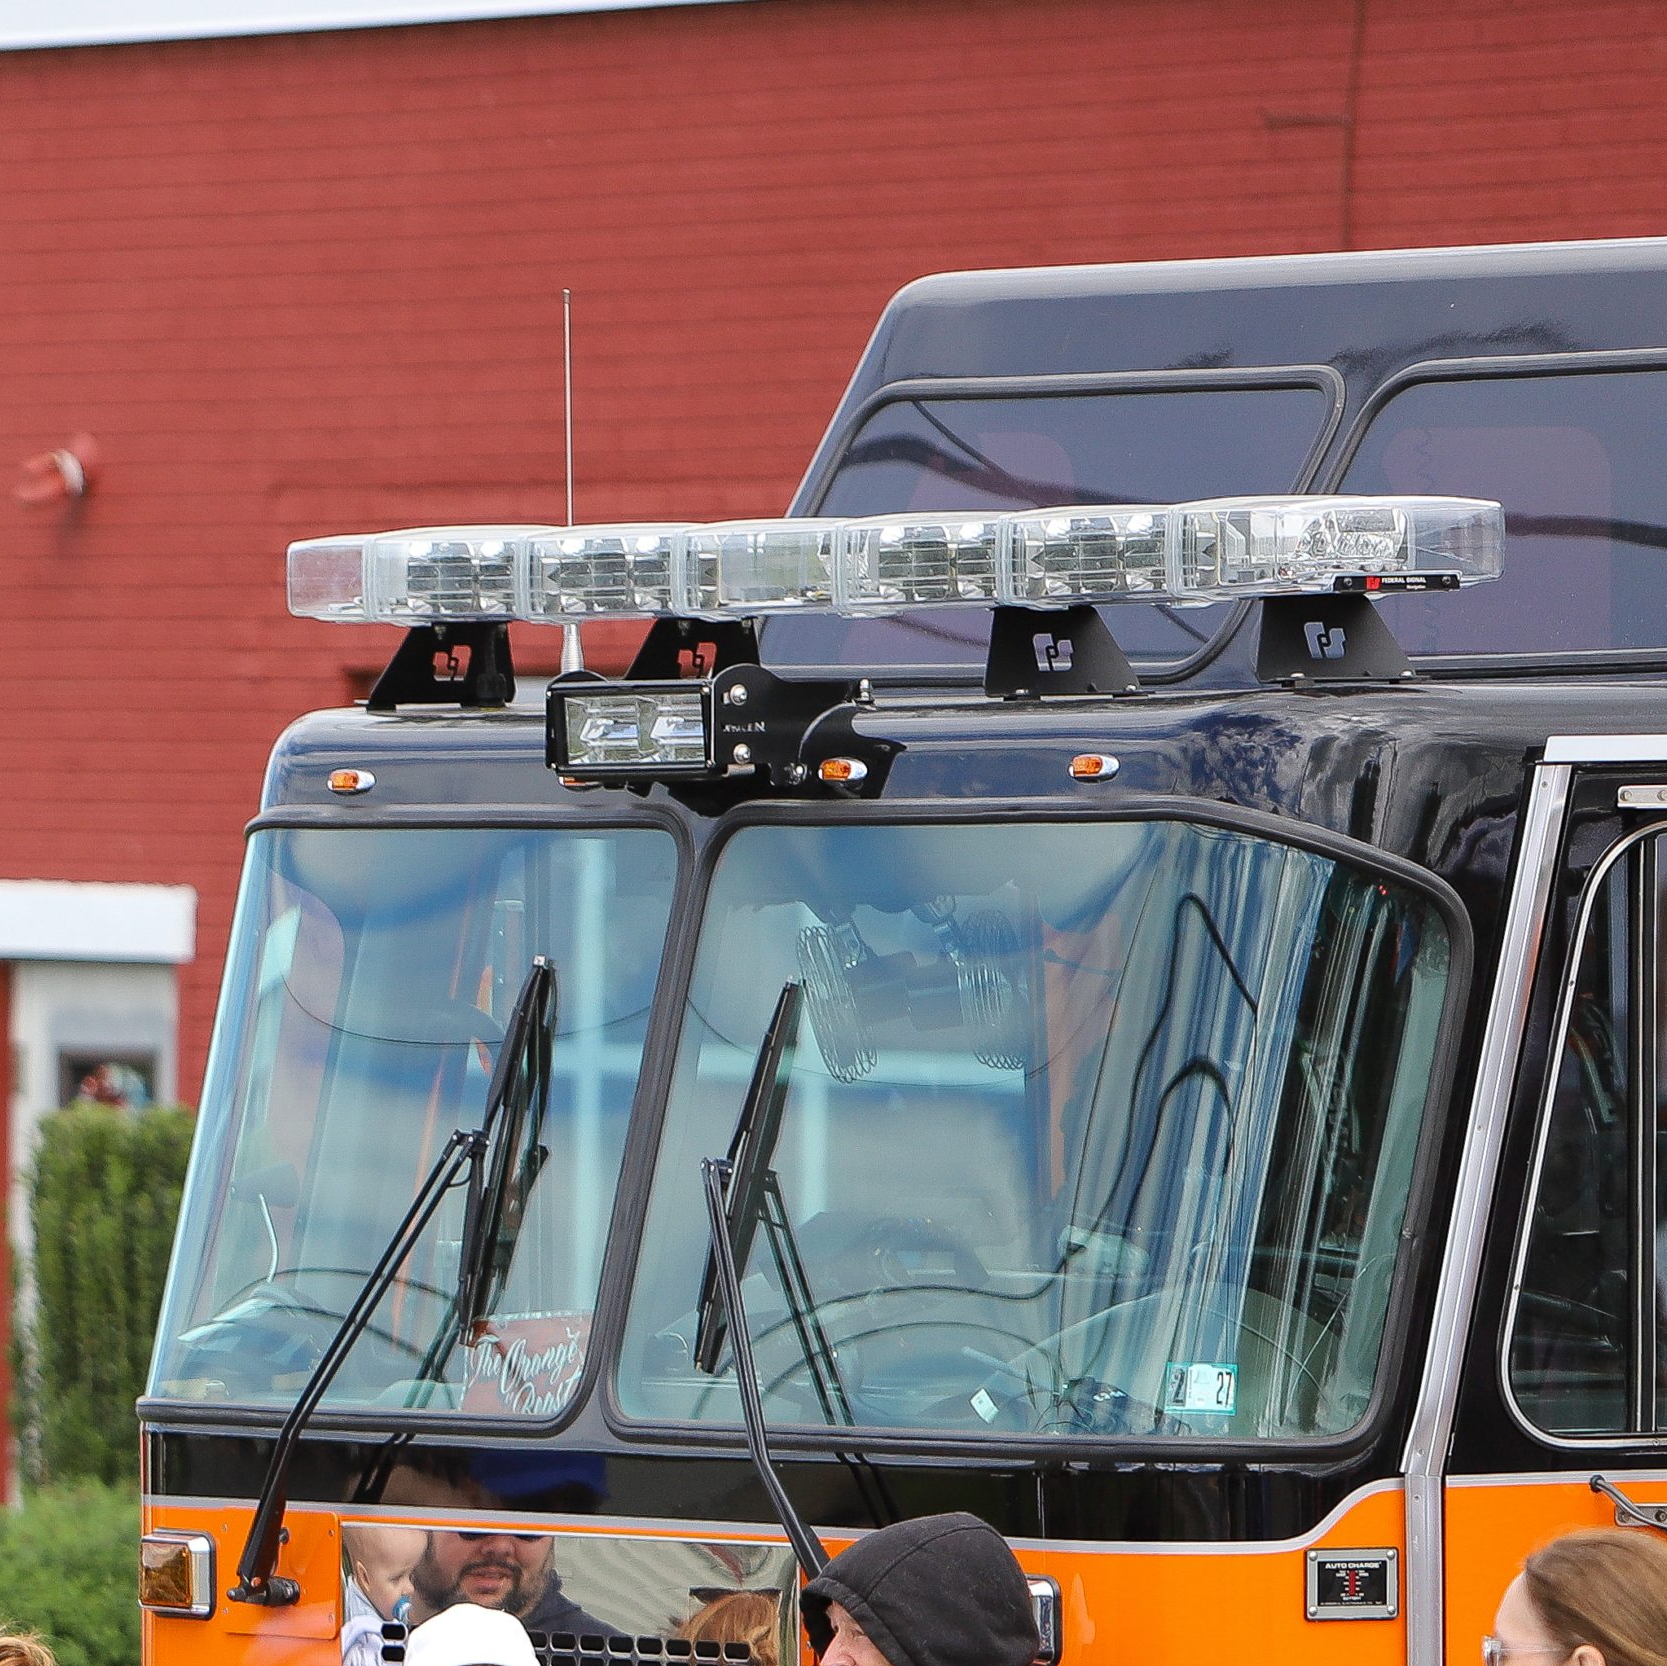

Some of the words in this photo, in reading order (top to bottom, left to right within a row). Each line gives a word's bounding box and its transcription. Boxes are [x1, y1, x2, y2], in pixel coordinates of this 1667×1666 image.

[468, 1334, 501, 1388] The
[500, 1338, 578, 1394] Orange
[1216, 1371, 1233, 1406] 27
